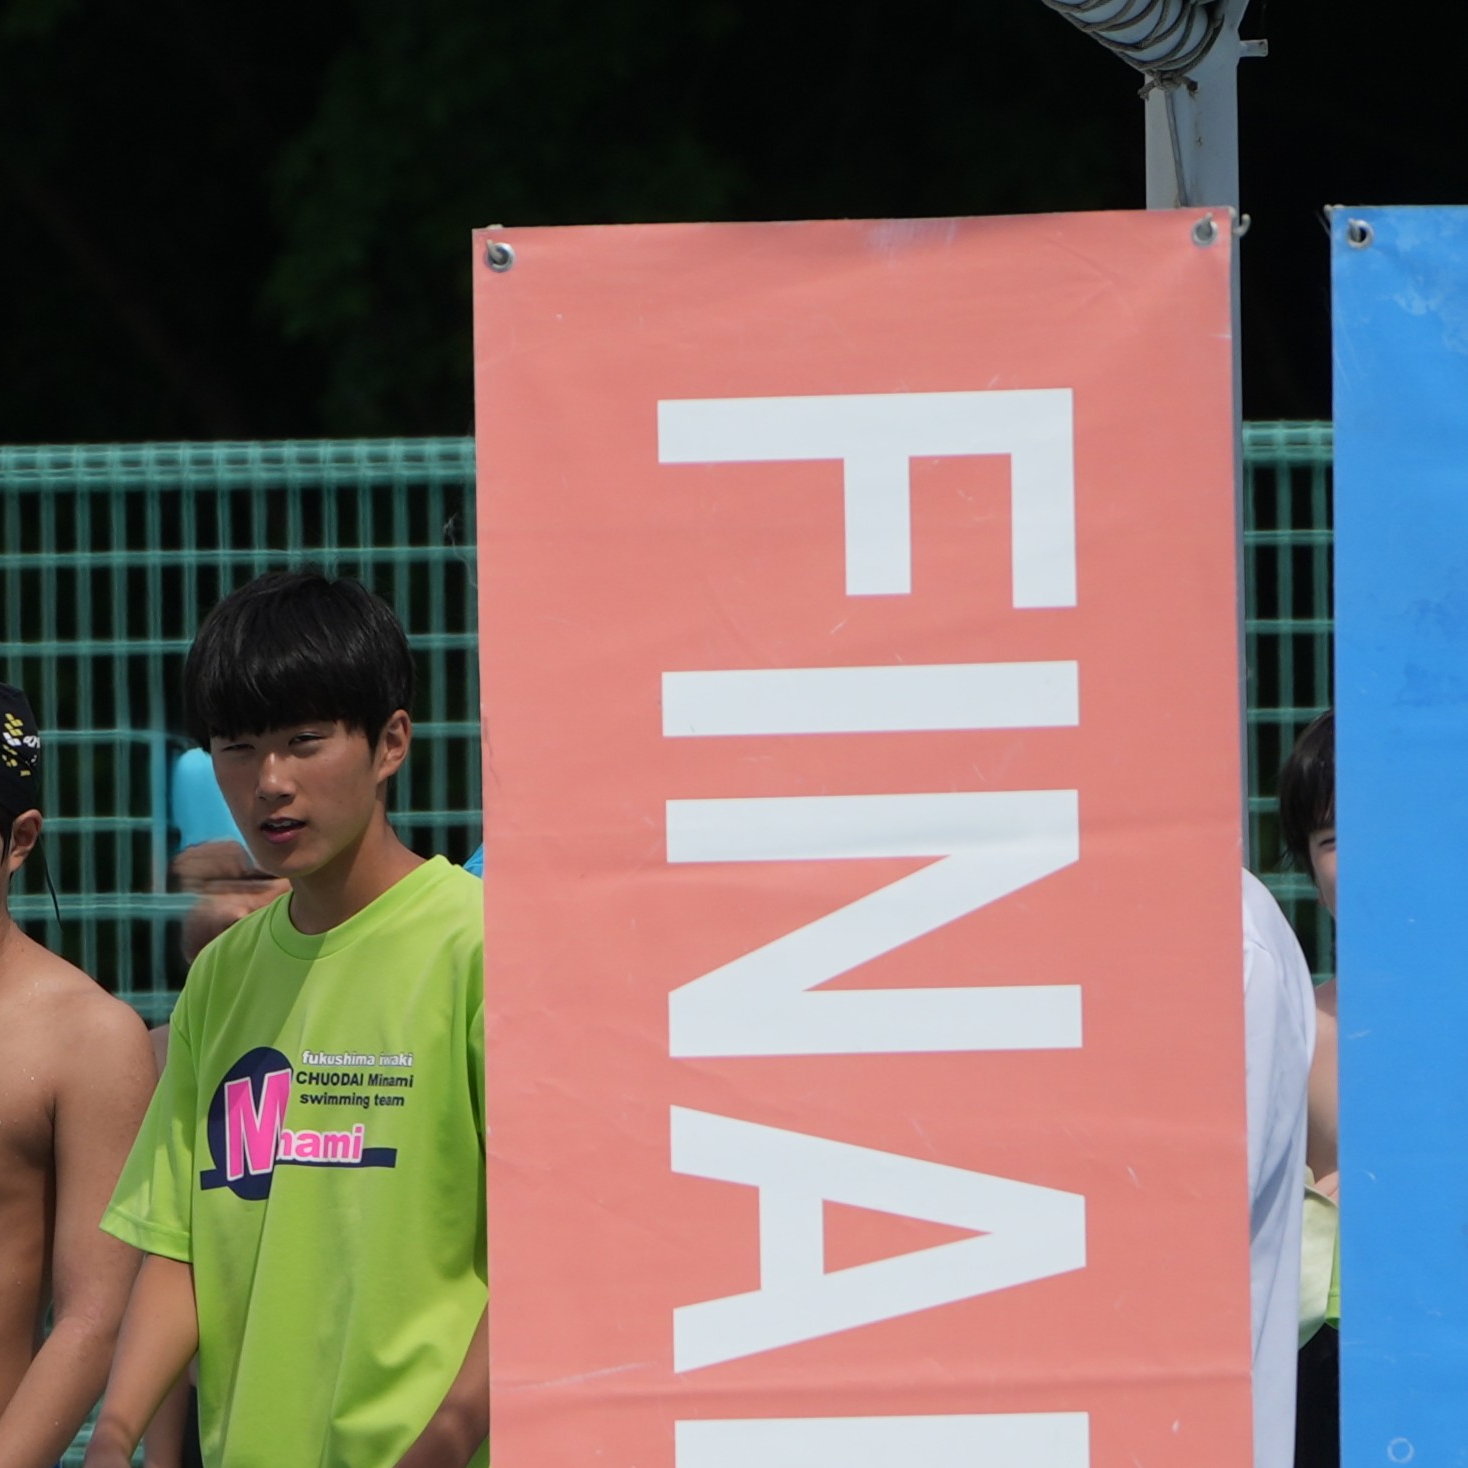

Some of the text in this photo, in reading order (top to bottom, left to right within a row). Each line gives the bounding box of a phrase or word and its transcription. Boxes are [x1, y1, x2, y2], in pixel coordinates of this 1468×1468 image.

[302, 1050, 413, 1067] fukushima iwaki
[296, 1071, 413, 1088] CHUODAI Minami
[300, 1093, 405, 1109] swimming team
[224, 1068, 364, 1181] Mnami
